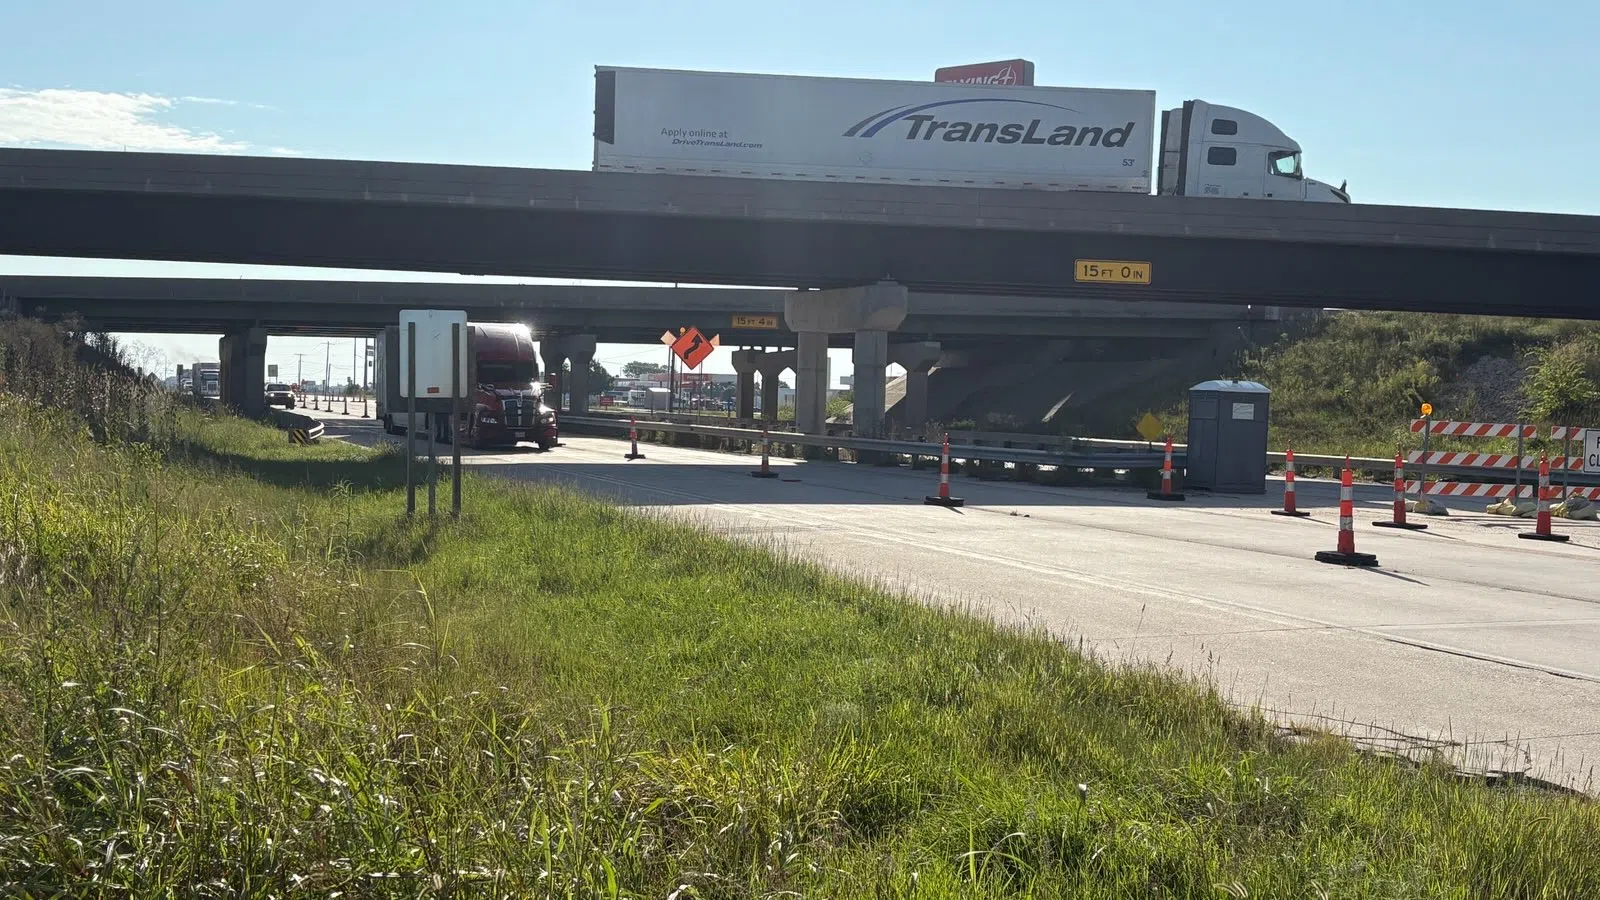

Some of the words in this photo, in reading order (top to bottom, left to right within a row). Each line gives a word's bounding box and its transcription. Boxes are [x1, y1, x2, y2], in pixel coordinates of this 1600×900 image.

[944, 76, 999, 85] YING
[661, 128, 687, 138] Apply
[689, 129, 717, 138] online
[718, 130, 728, 138] at
[903, 114, 1135, 147] TransLand
[672, 138, 763, 148] DriveTransLand.com
[1083, 265, 1099, 277] 15
[1101, 269, 1113, 278] FT
[1121, 266, 1130, 278] 0
[1133, 271, 1143, 279] IN
[736, 316, 746, 325] 15
[758, 317, 765, 326] 4
